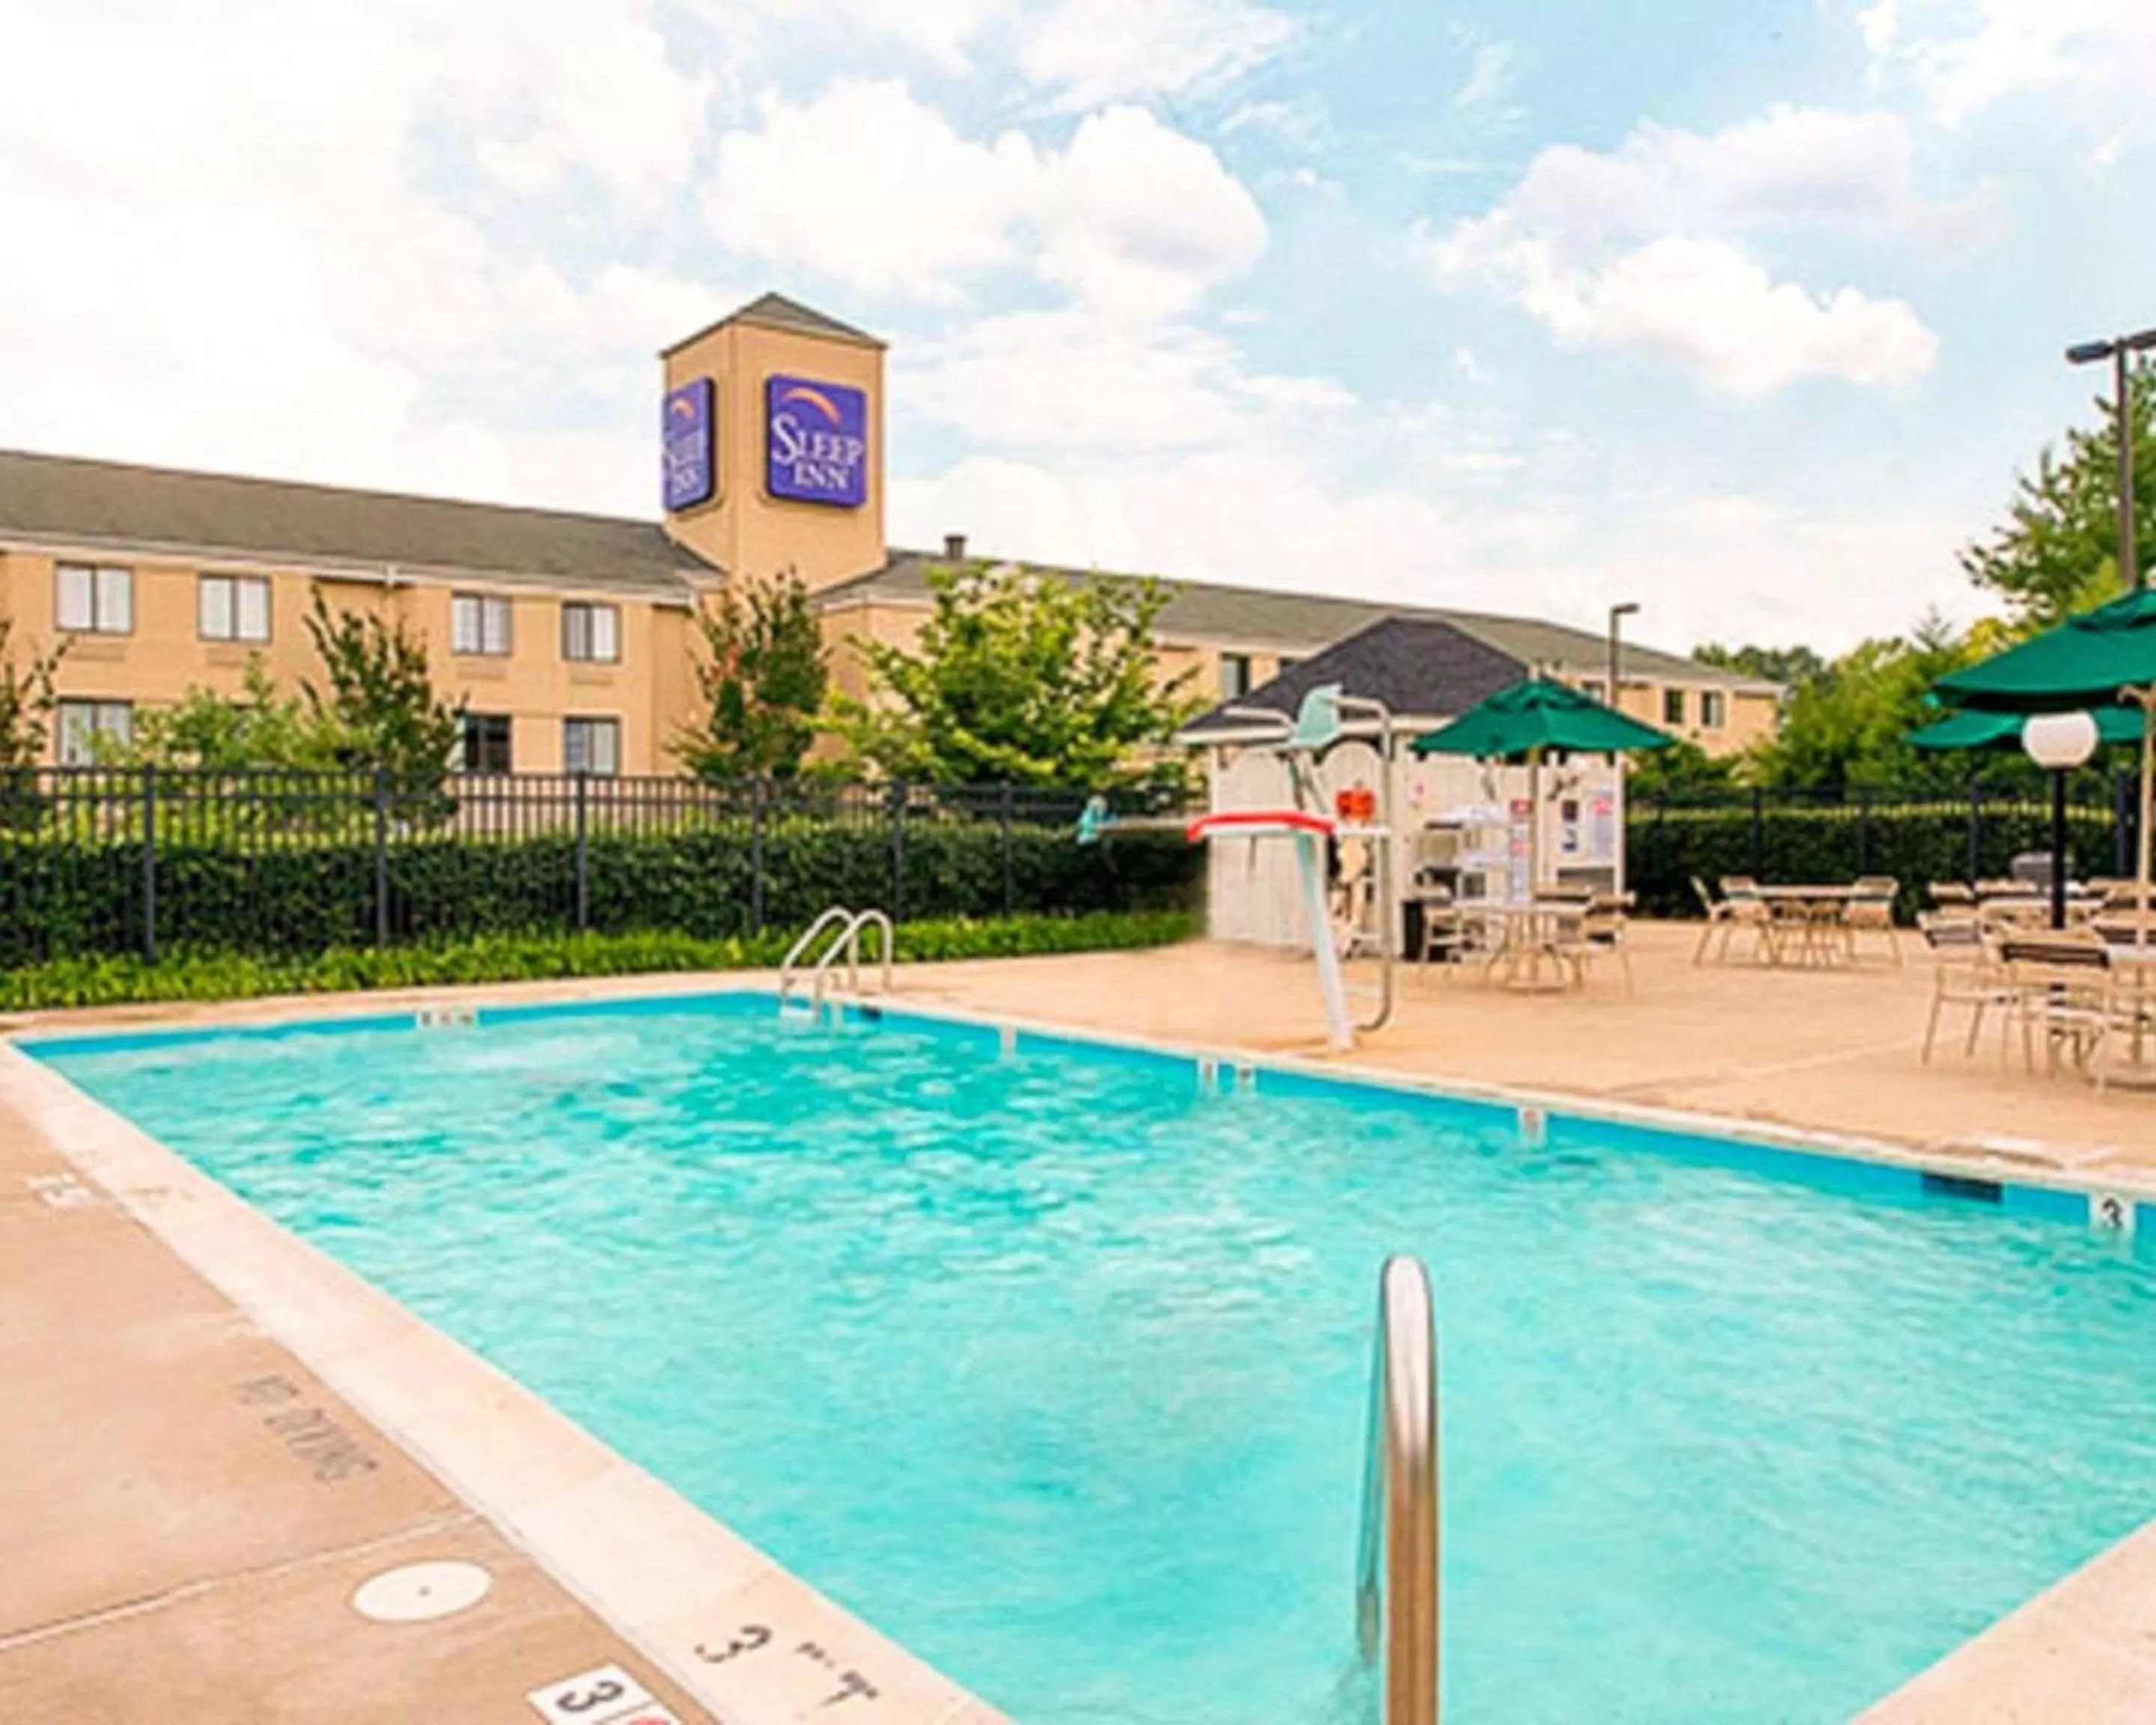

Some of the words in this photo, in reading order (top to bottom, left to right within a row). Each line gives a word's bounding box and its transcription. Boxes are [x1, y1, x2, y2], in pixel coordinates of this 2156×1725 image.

[771, 413, 864, 465] SLEEP
[794, 459, 850, 489] INN
[693, 1622, 773, 1663] 3
[556, 1679, 626, 1712] 3
